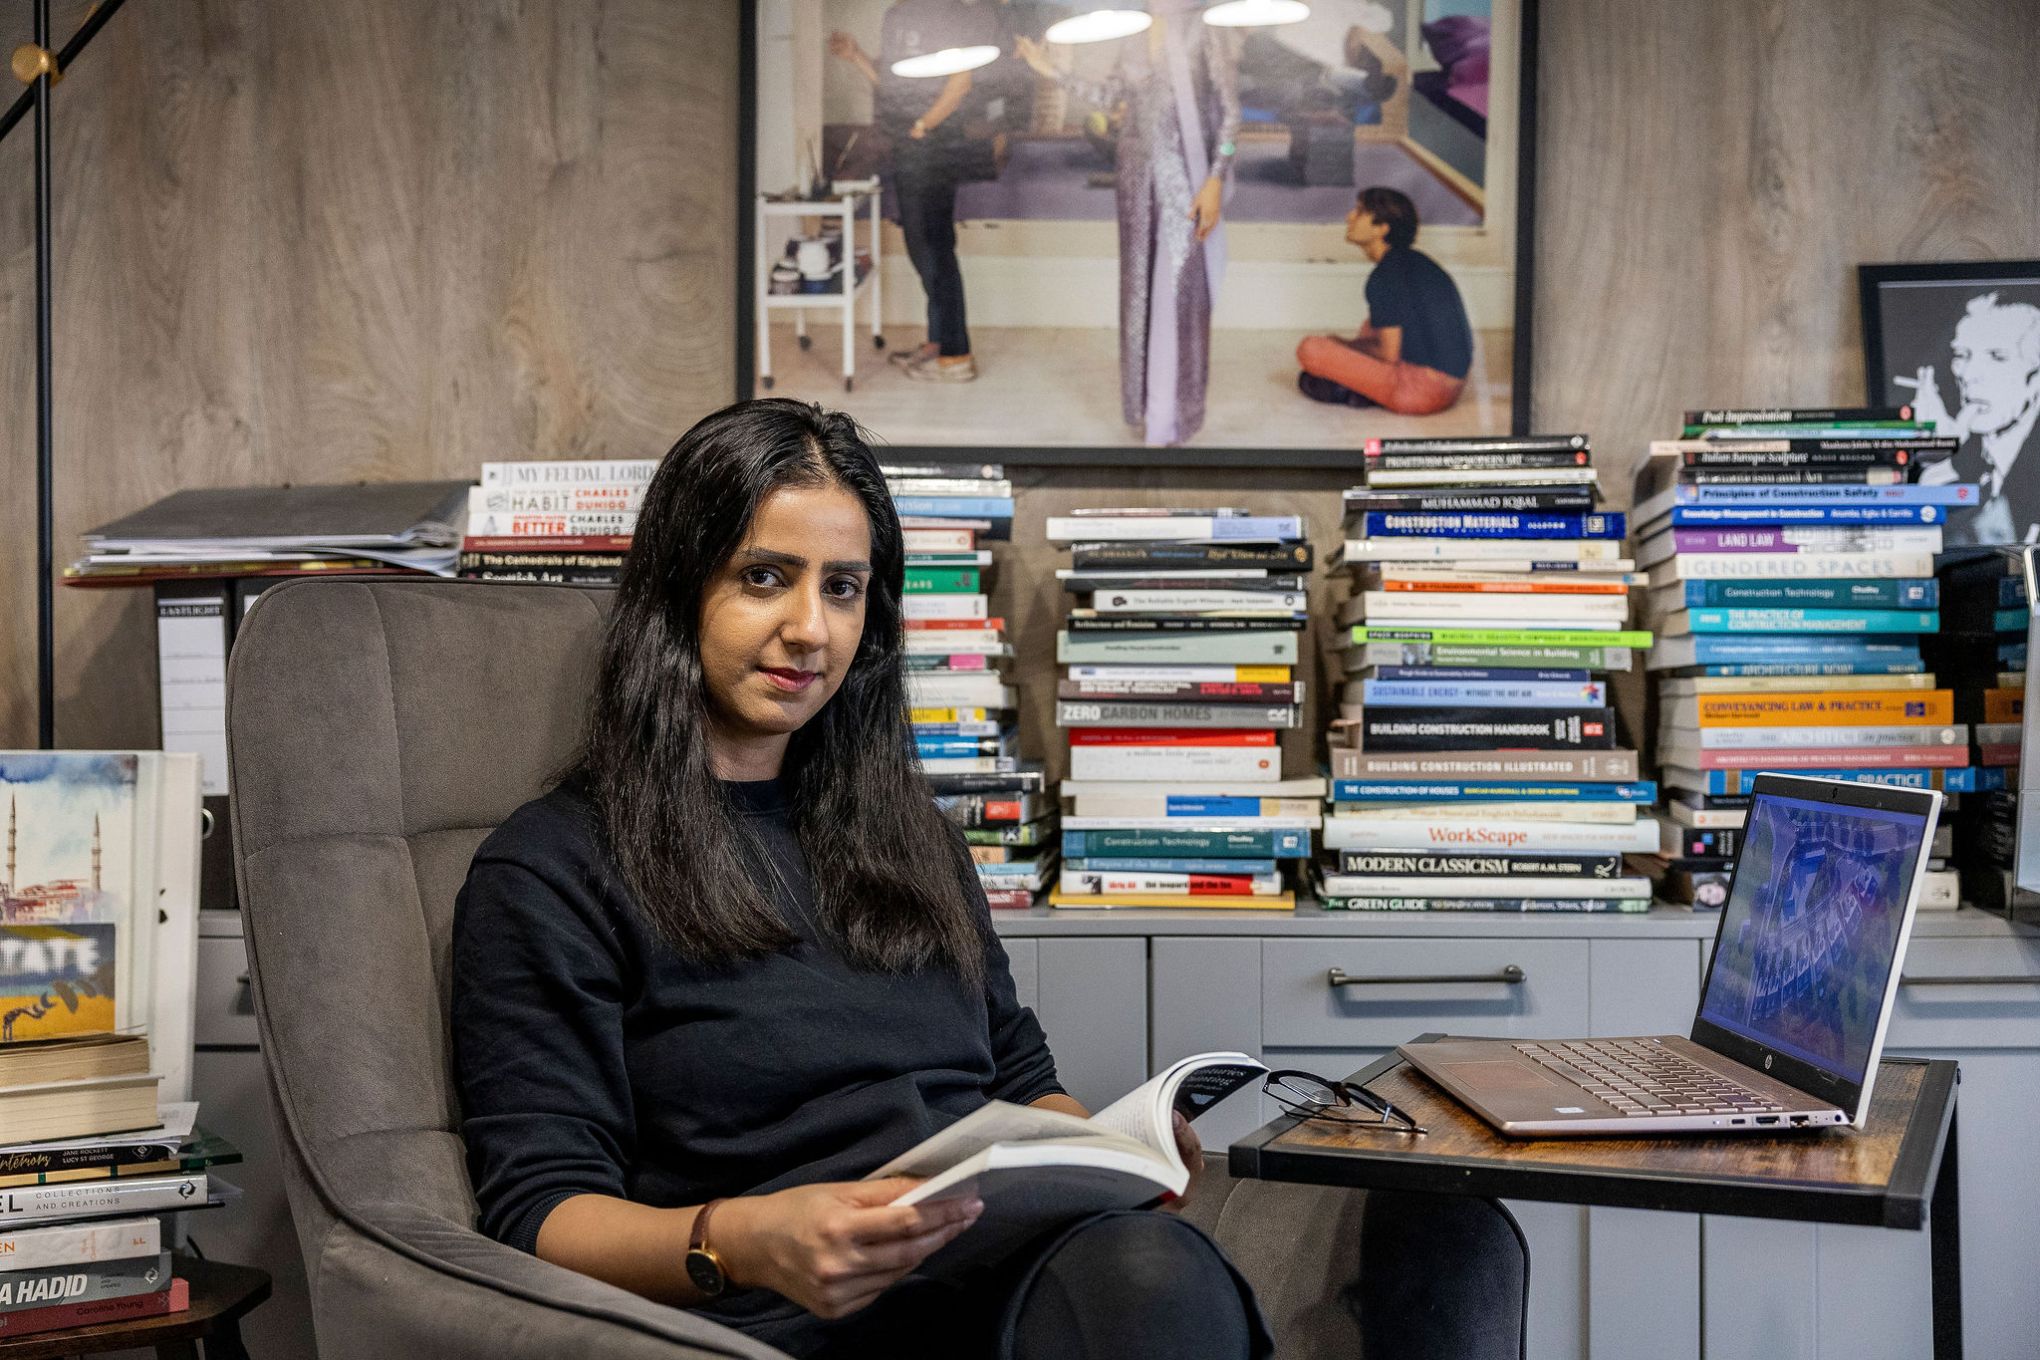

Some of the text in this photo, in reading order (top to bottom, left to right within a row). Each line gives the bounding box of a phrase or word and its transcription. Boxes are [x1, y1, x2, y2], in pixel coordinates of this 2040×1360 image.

[575, 489, 629, 498] CHARLES
[1703, 487, 1878, 499] Principles of Construction Safety
[512, 497, 569, 511] HABIT
[1421, 496, 1538, 510] MUHAMMAD IQBAL
[570, 515, 624, 524] CHARLES
[512, 522, 566, 535] BETTER
[1717, 533, 1774, 547] LAND LAW
[483, 554, 504, 566] The
[564, 555, 576, 566] of
[578, 555, 622, 567] England
[1694, 559, 1895, 577] GENDERED SPACES
[1725, 587, 1835, 599] Construction Technology
[1436, 647, 1580, 659] Environmental Science in Building
[1063, 704, 1212, 720] ZERO CARBON HOMES
[1703, 701, 1882, 712] CONVEYANCING LAW & PRACTICE
[1370, 723, 1550, 736] BUILDING CONSTRUCTION HANDBOOK
[1367, 761, 1573, 773] BUILDING CONSTRUCTION ILLUSTRATED
[1345, 786, 1358, 794] THE
[1104, 836, 1211, 849] Construction Technology
[1428, 826, 1528, 847] WorkScape
[1347, 857, 1510, 874] MODERN CLASSICISM
[1511, 863, 1540, 873] ROBERT
[1559, 864, 1582, 874] STERN
[1348, 899, 1388, 910] GREEN
[1389, 899, 1427, 910] GUIDE
[0, 1152, 52, 1171] nteriors
[62, 1156, 80, 1164] LUCY
[89, 1153, 115, 1161] GEORGE
[36, 1186, 121, 1200] COLLECTIONS
[36, 1197, 121, 1211] AND CREATIONS
[16, 1273, 88, 1304] HADID
[76, 1299, 144, 1316] Caroline Young
